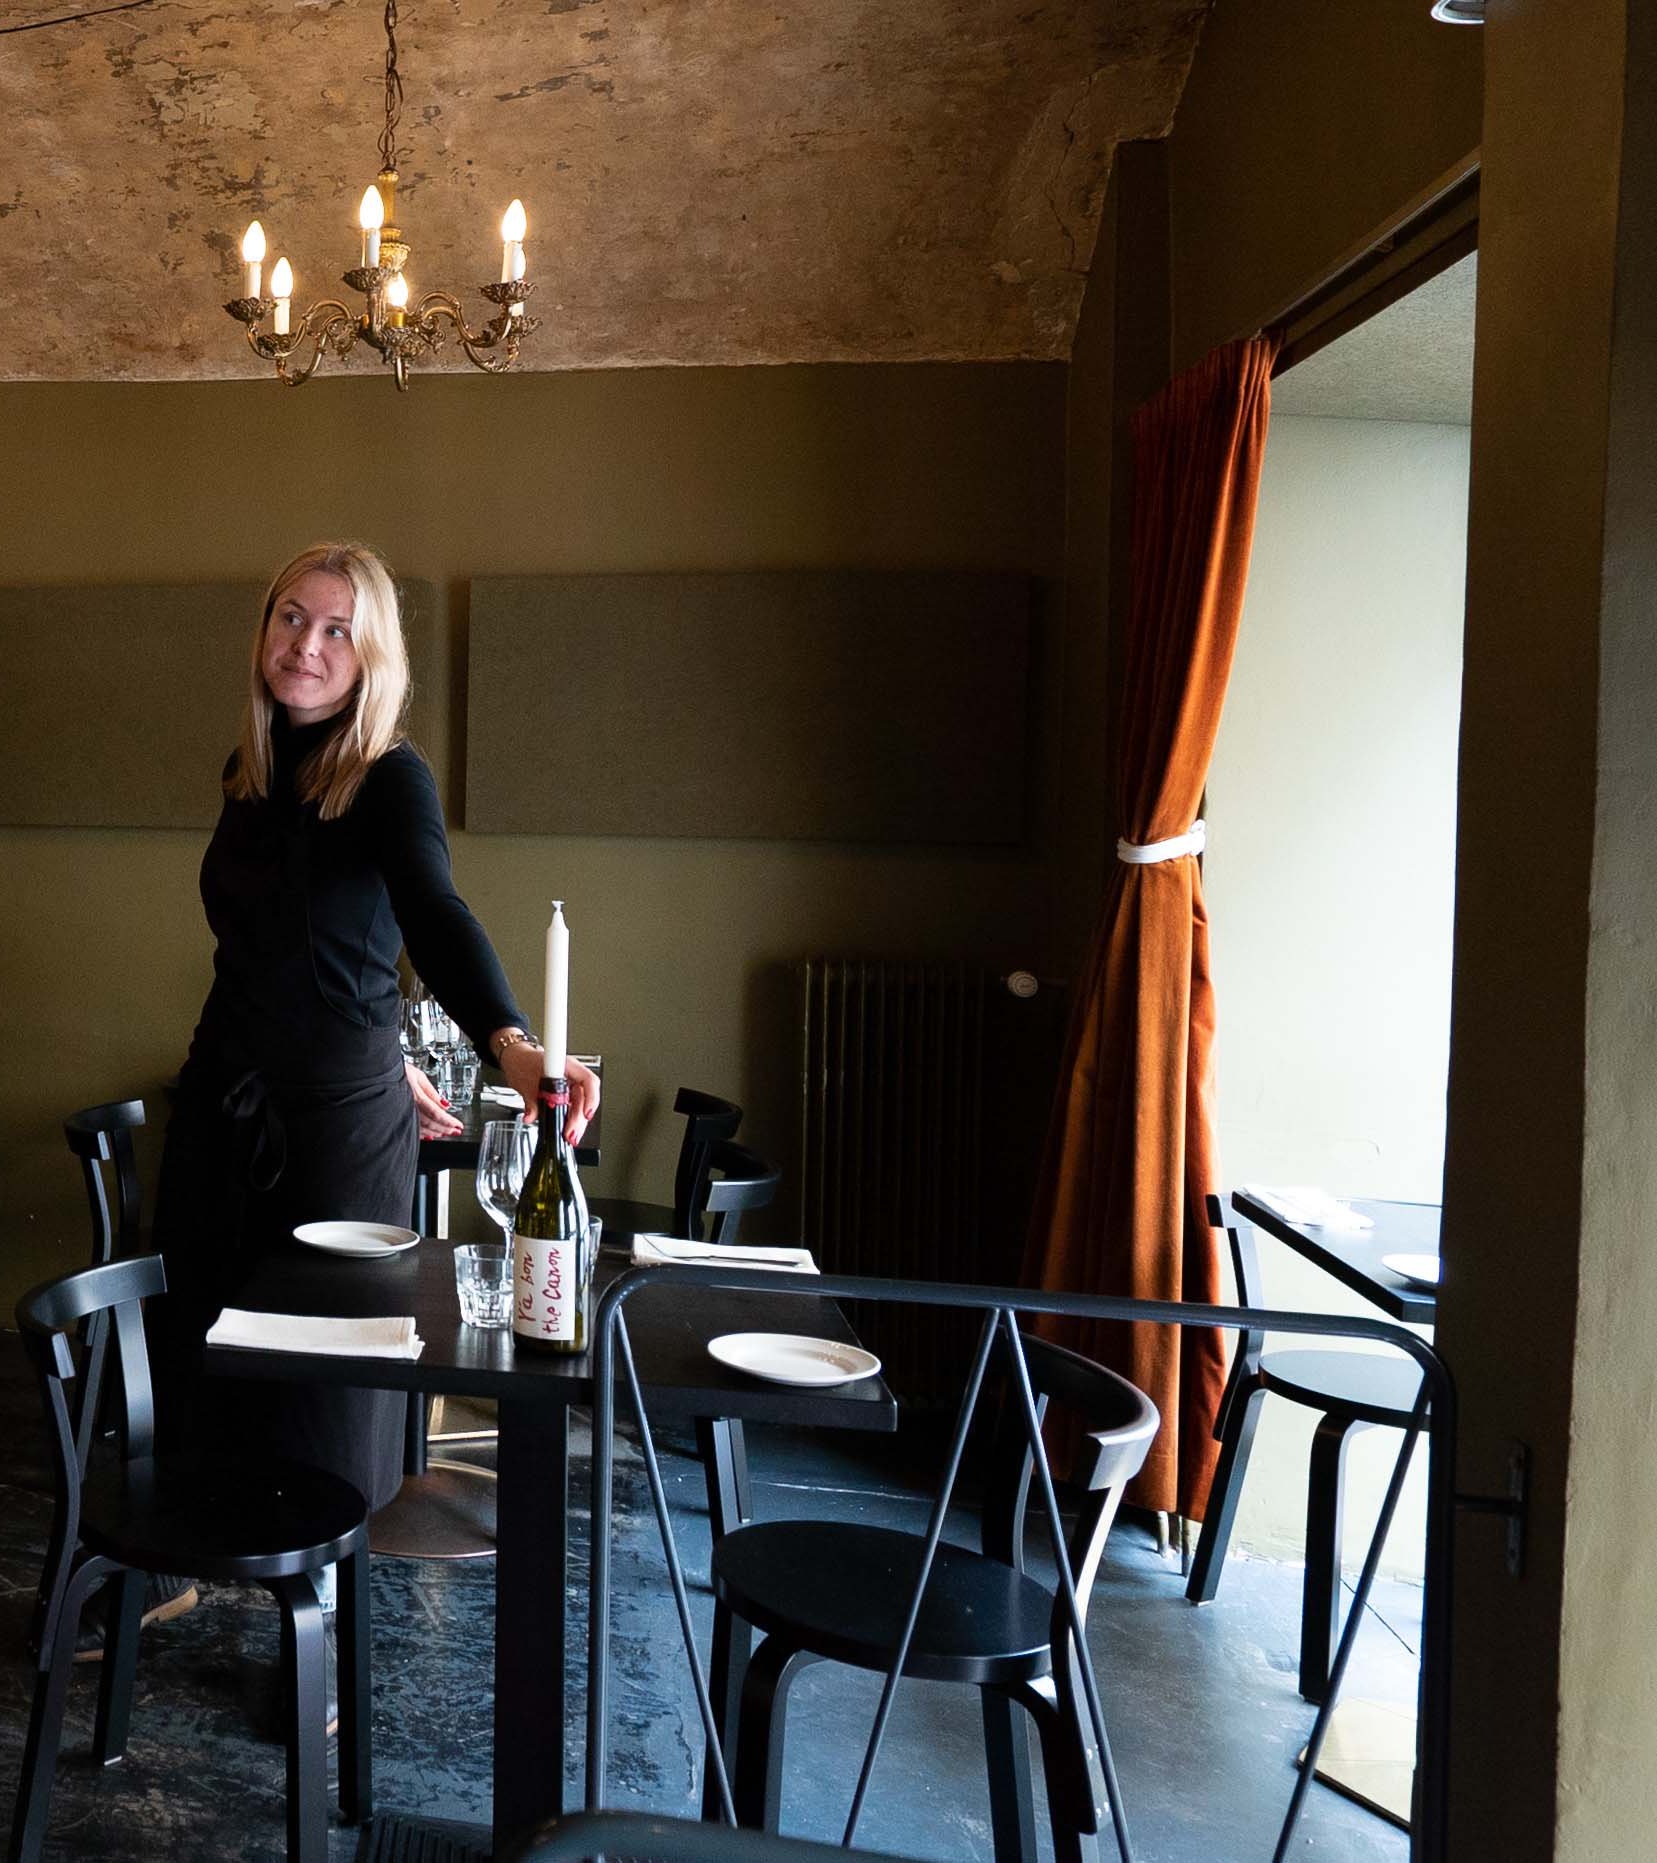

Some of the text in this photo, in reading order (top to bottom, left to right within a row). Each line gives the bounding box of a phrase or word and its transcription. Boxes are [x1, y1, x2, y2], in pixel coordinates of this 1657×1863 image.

[519, 1251, 536, 1285] bon
[542, 1246, 562, 1334] the Canon
